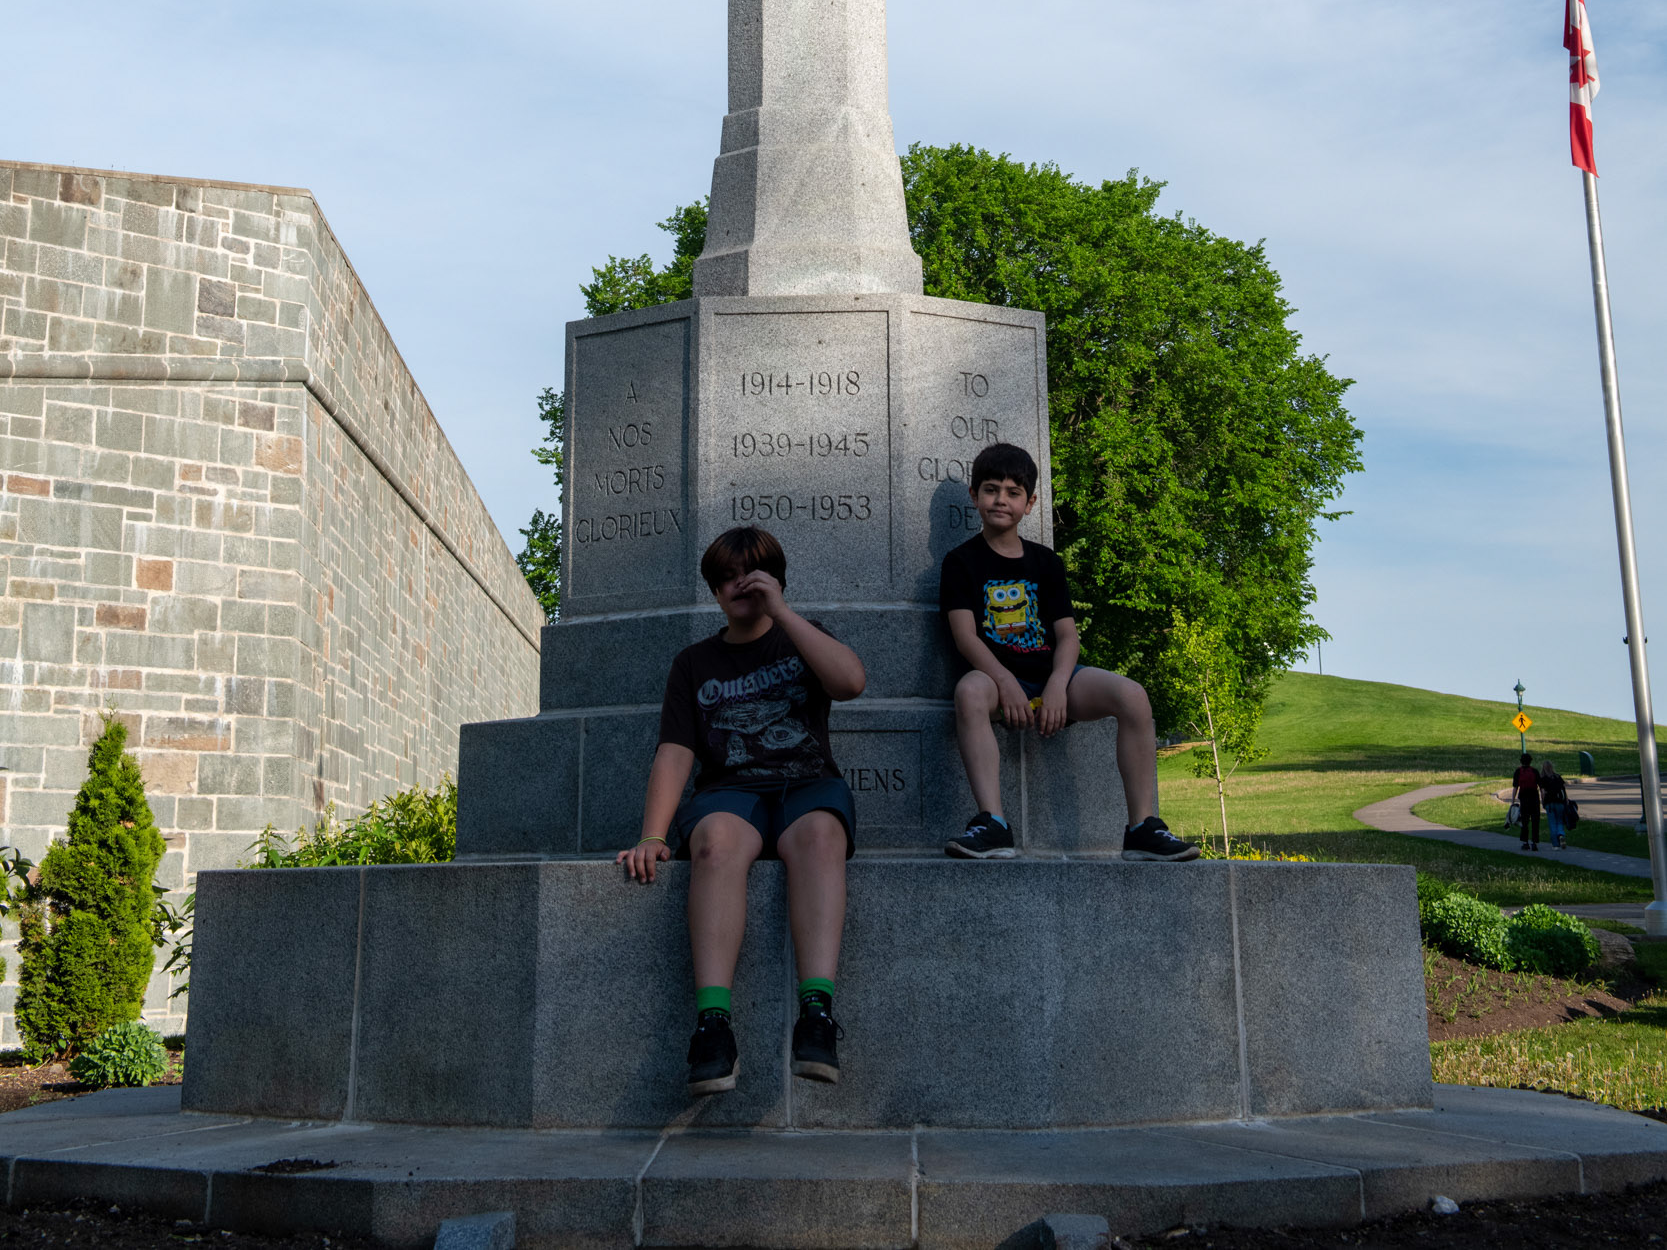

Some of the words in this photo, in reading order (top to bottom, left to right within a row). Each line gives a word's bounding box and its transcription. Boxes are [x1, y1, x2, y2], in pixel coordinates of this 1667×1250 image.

[742, 371, 861, 396] 1914-1918
[959, 371, 989, 398] TO
[608, 422, 652, 451] NOS
[951, 415, 999, 444] OUR
[732, 433, 869, 458] 1939-1945
[593, 465, 665, 496] MORTS
[732, 494, 872, 521] 1950-1953
[949, 504, 982, 531] DE
[576, 508, 683, 544] GLORIEUX
[843, 768, 905, 793] IENS
